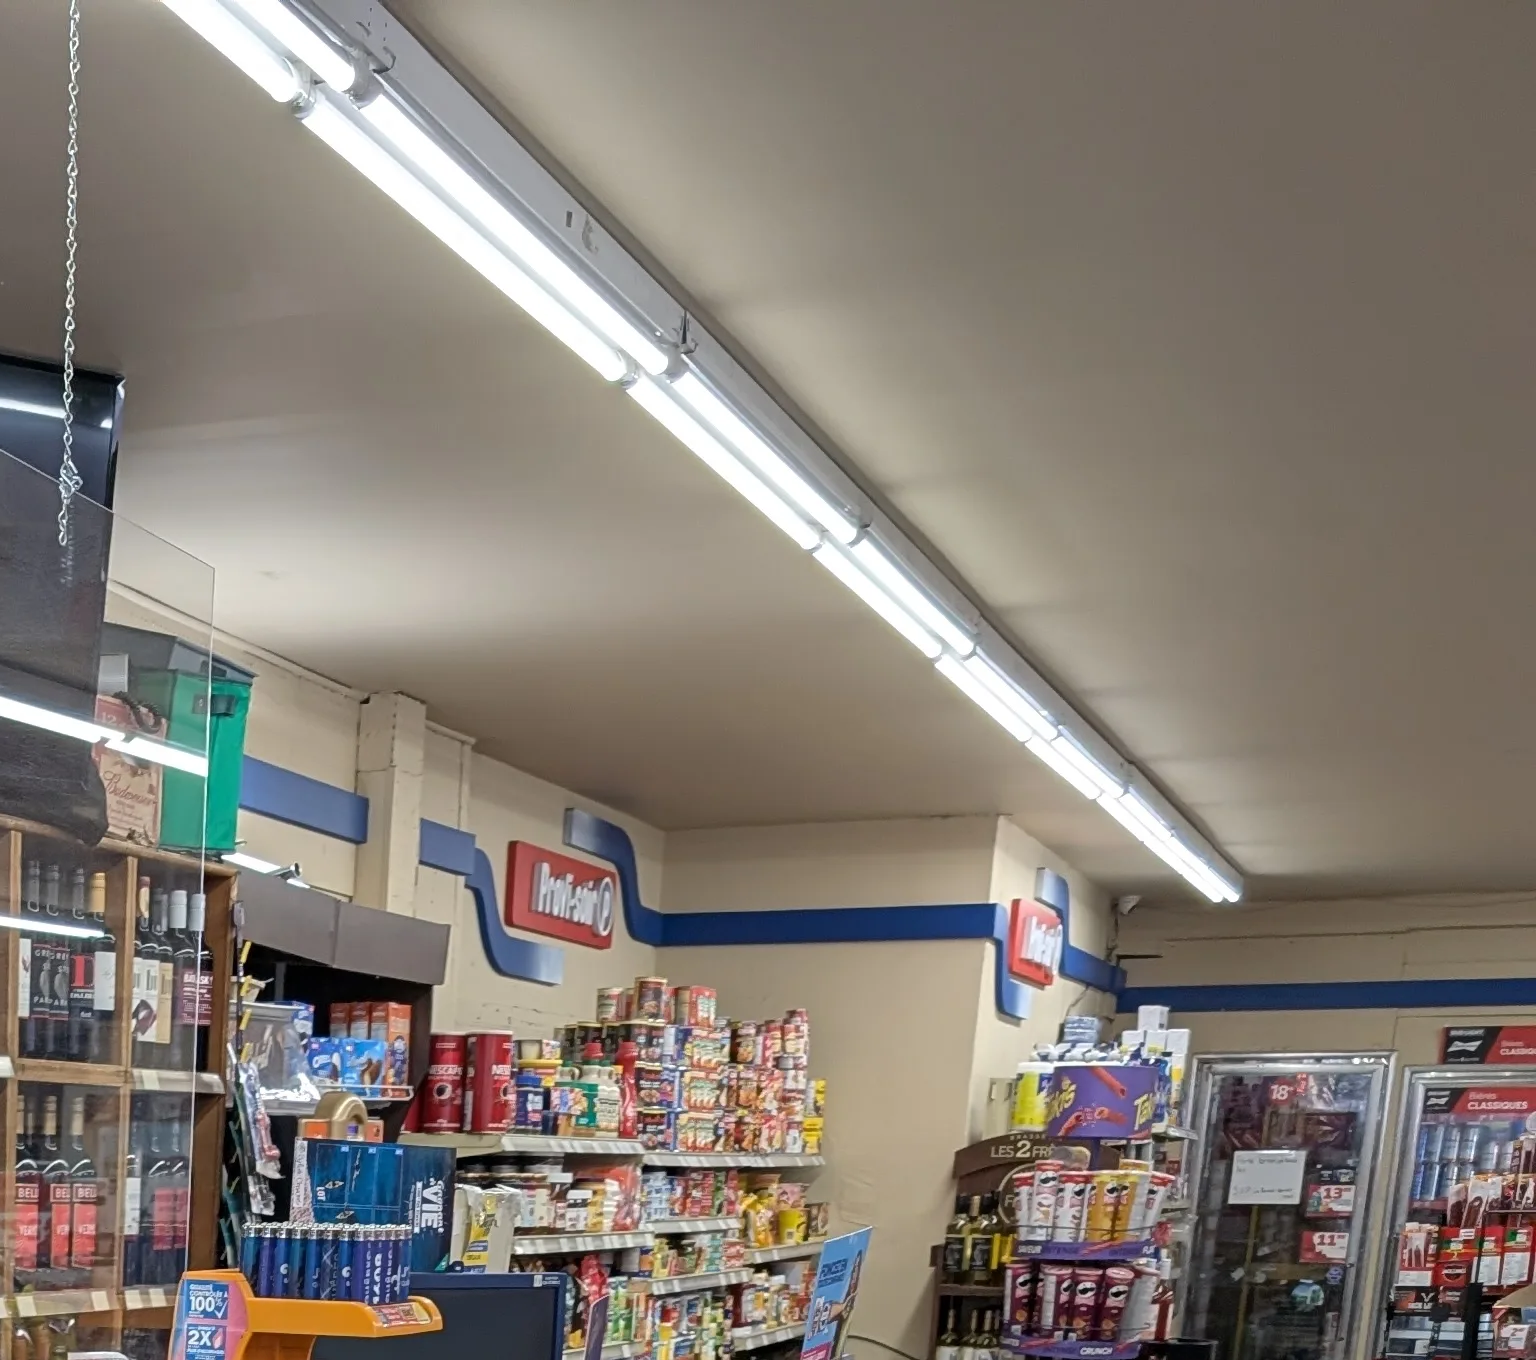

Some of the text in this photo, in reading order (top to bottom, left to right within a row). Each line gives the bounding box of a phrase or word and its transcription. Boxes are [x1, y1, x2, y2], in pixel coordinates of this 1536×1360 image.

[1467, 1101, 1528, 1110] CLASSIQUES
[991, 1140, 1031, 1158] LES 2
[187, 1329, 213, 1348] 2X
[1080, 1346, 1113, 1356] CRUNCH
